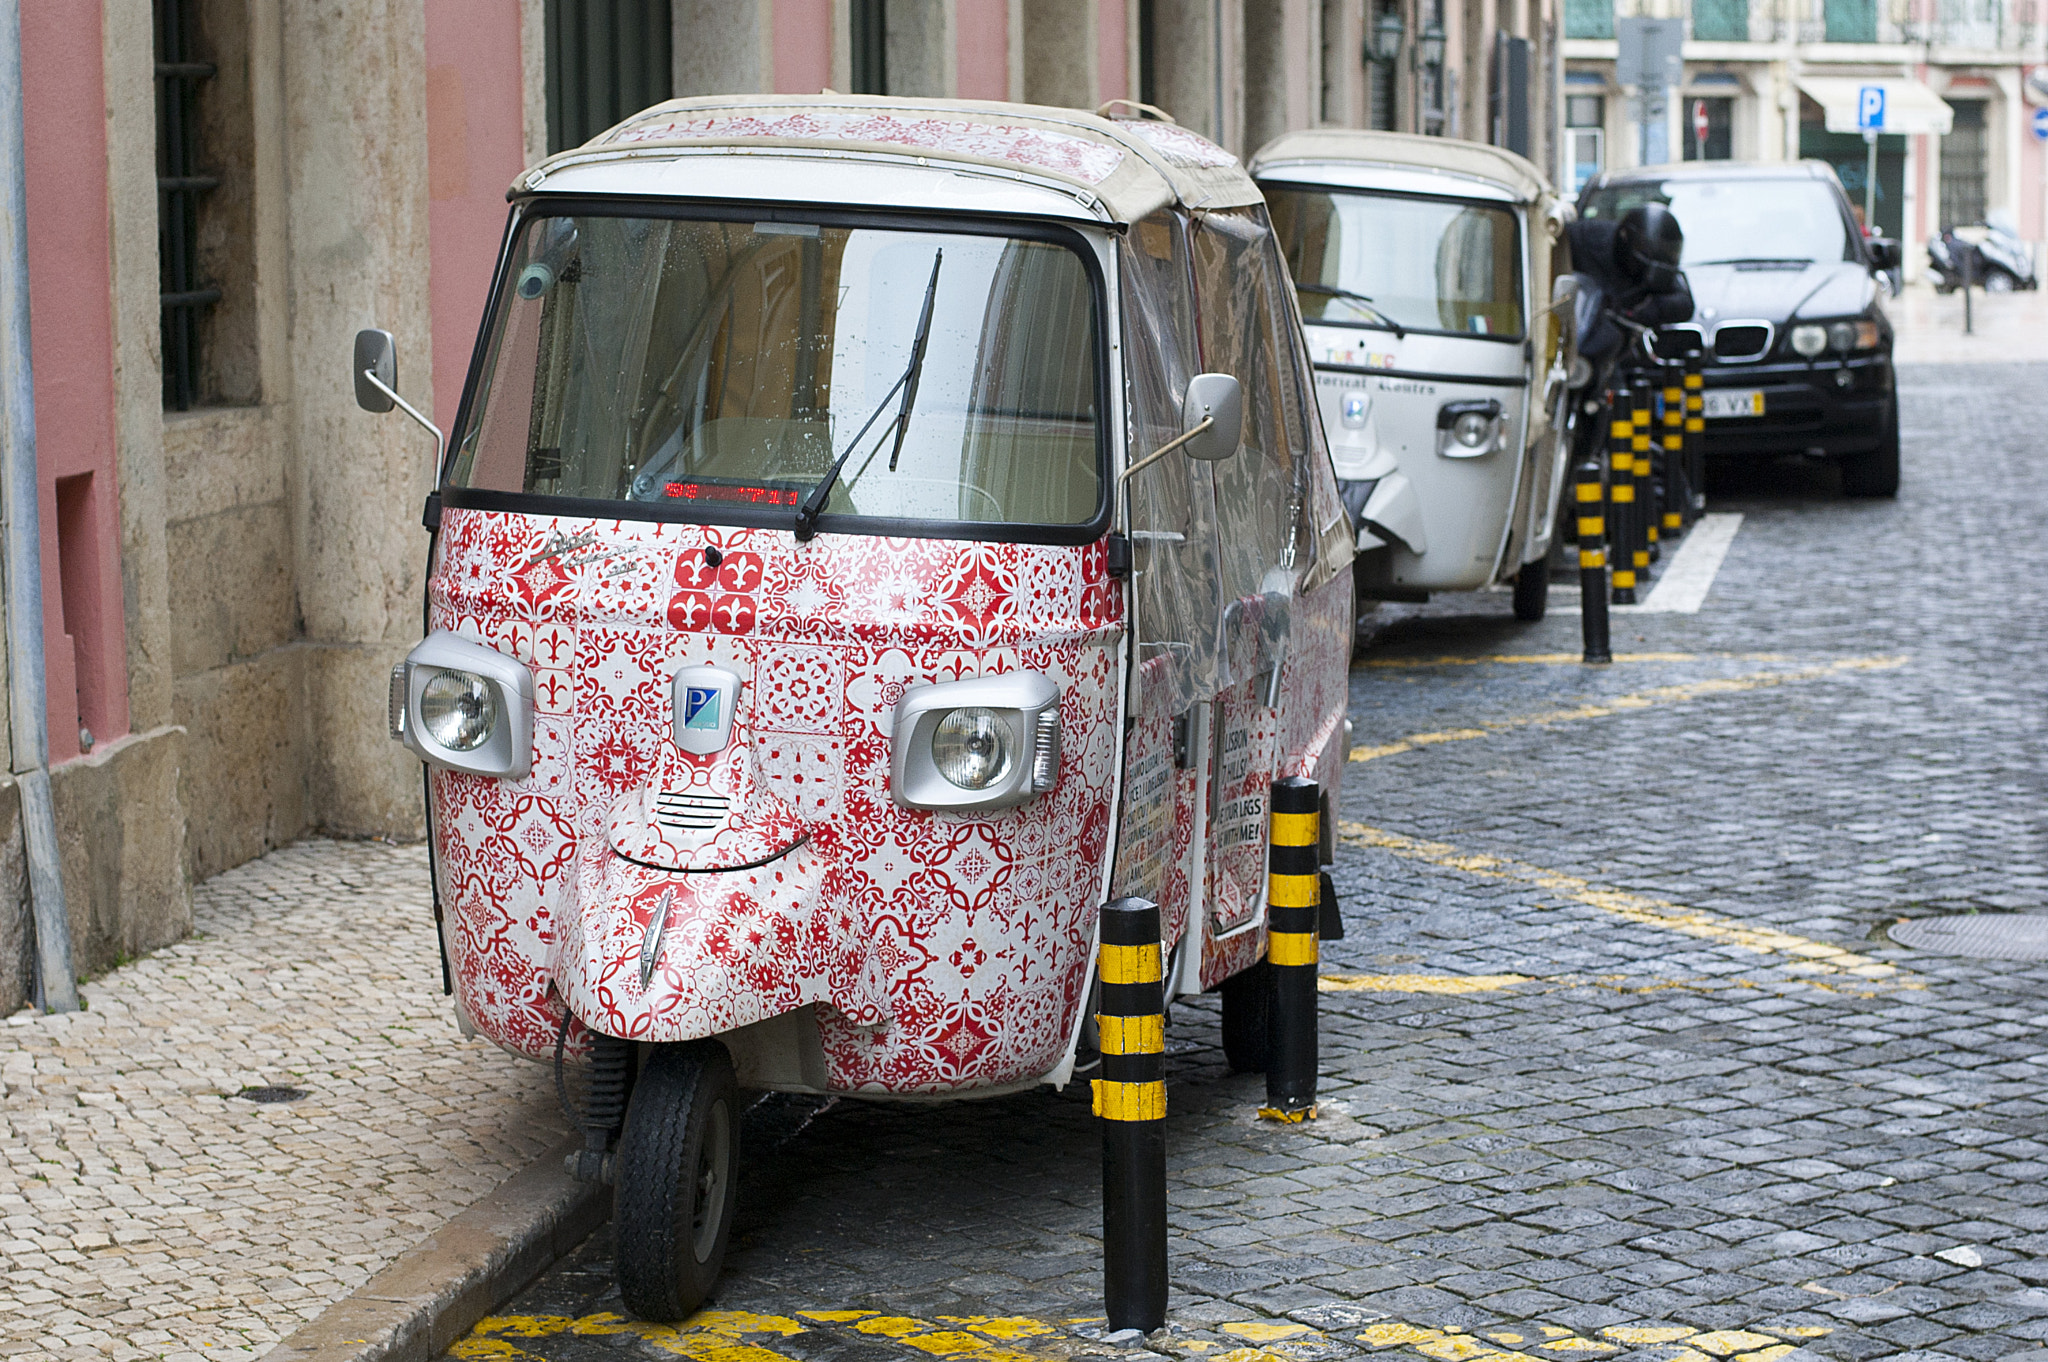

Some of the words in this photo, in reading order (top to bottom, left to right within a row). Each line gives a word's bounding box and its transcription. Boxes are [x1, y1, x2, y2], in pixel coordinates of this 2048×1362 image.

[1862, 89, 1882, 126] P
[686, 690, 707, 718] P
[1224, 727, 1248, 753] LISBON
[1239, 797, 1262, 818] LEGS
[1239, 823, 1260, 842] ME!
